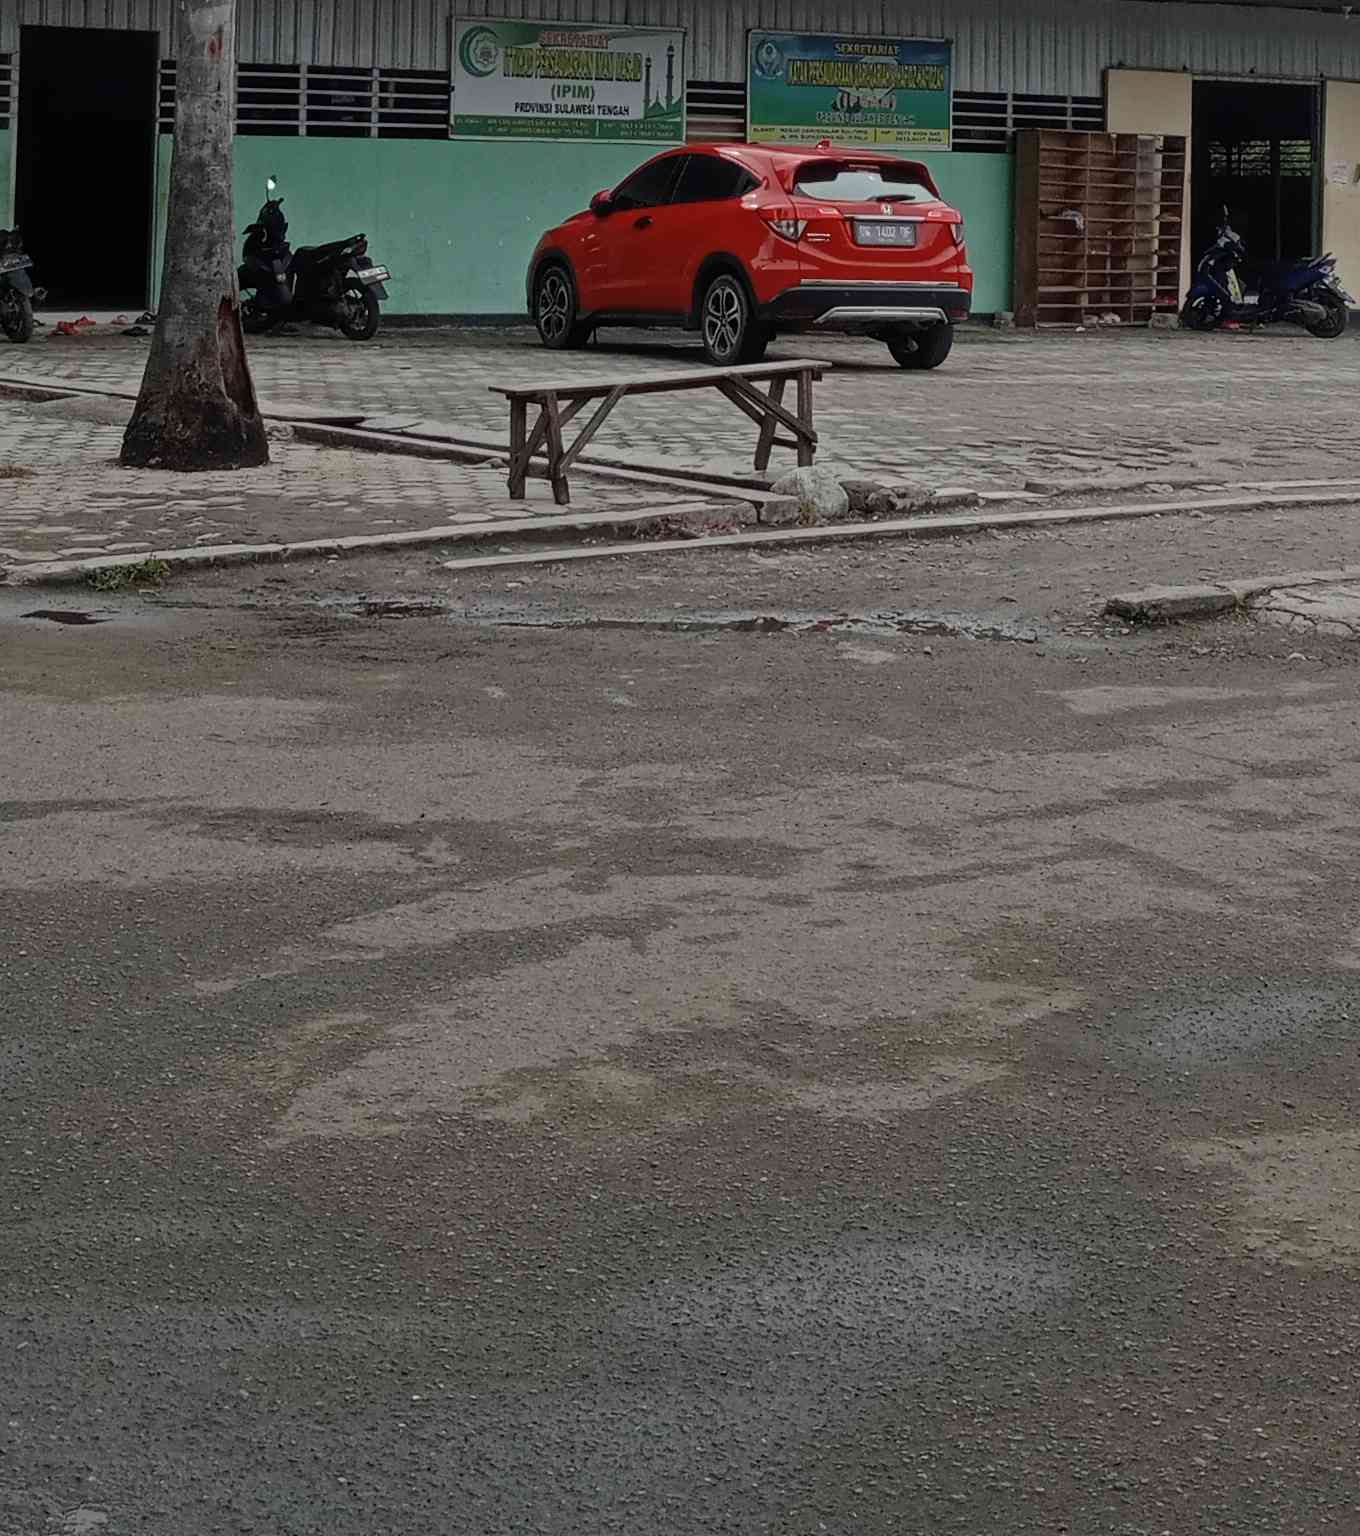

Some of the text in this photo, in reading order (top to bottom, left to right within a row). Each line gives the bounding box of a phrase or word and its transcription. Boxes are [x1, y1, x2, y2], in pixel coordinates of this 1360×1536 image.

[834, 43, 900, 56] SEKRETARIAT
[551, 84, 596, 101] (IPIM)
[514, 102, 630, 116] PROVINSI SULAWESI TENGAH
